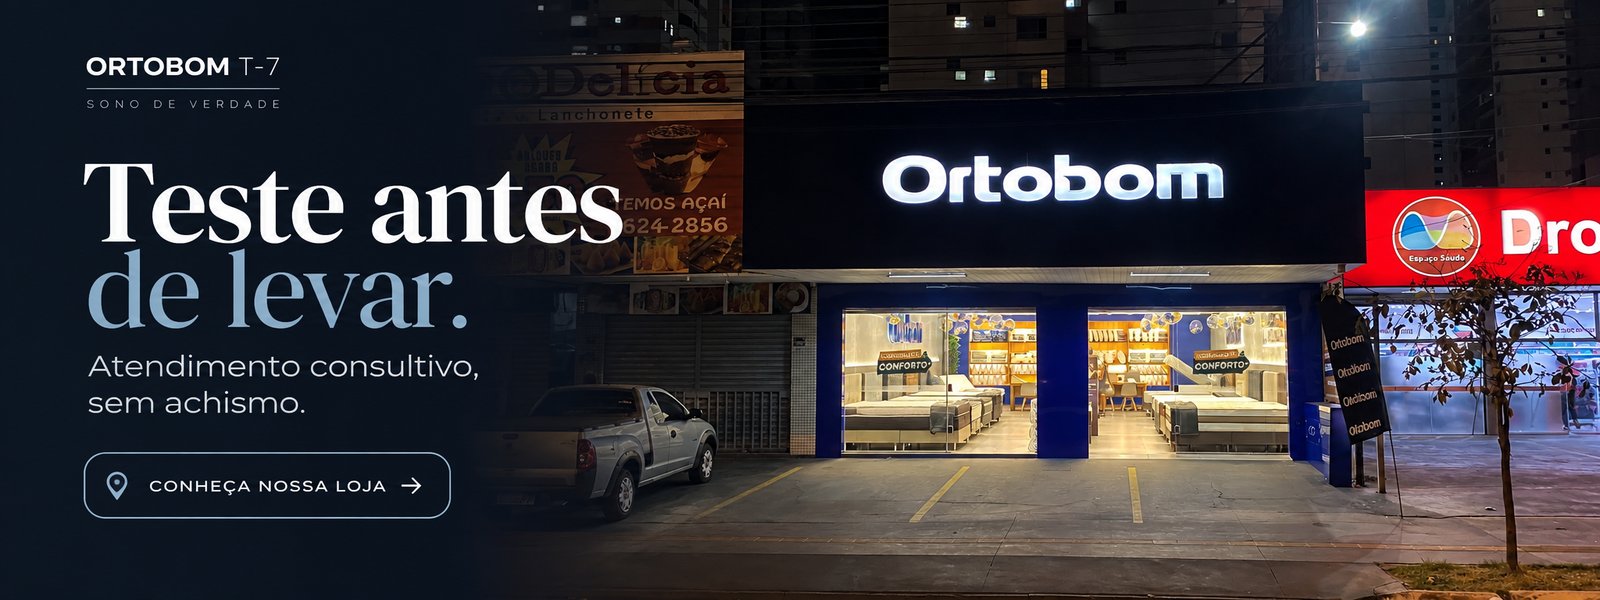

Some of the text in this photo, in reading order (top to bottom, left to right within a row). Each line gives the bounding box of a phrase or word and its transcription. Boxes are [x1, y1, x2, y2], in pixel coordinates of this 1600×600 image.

[538, 106, 655, 122] Lanchonete
[882, 154, 1225, 205] Ortobom
[613, 193, 727, 213] TEMOS AÇAÍ
[1501, 209, 1600, 255] Dro
[1409, 255, 1438, 263] Espaço
[1194, 361, 1245, 370] CONFORTO
